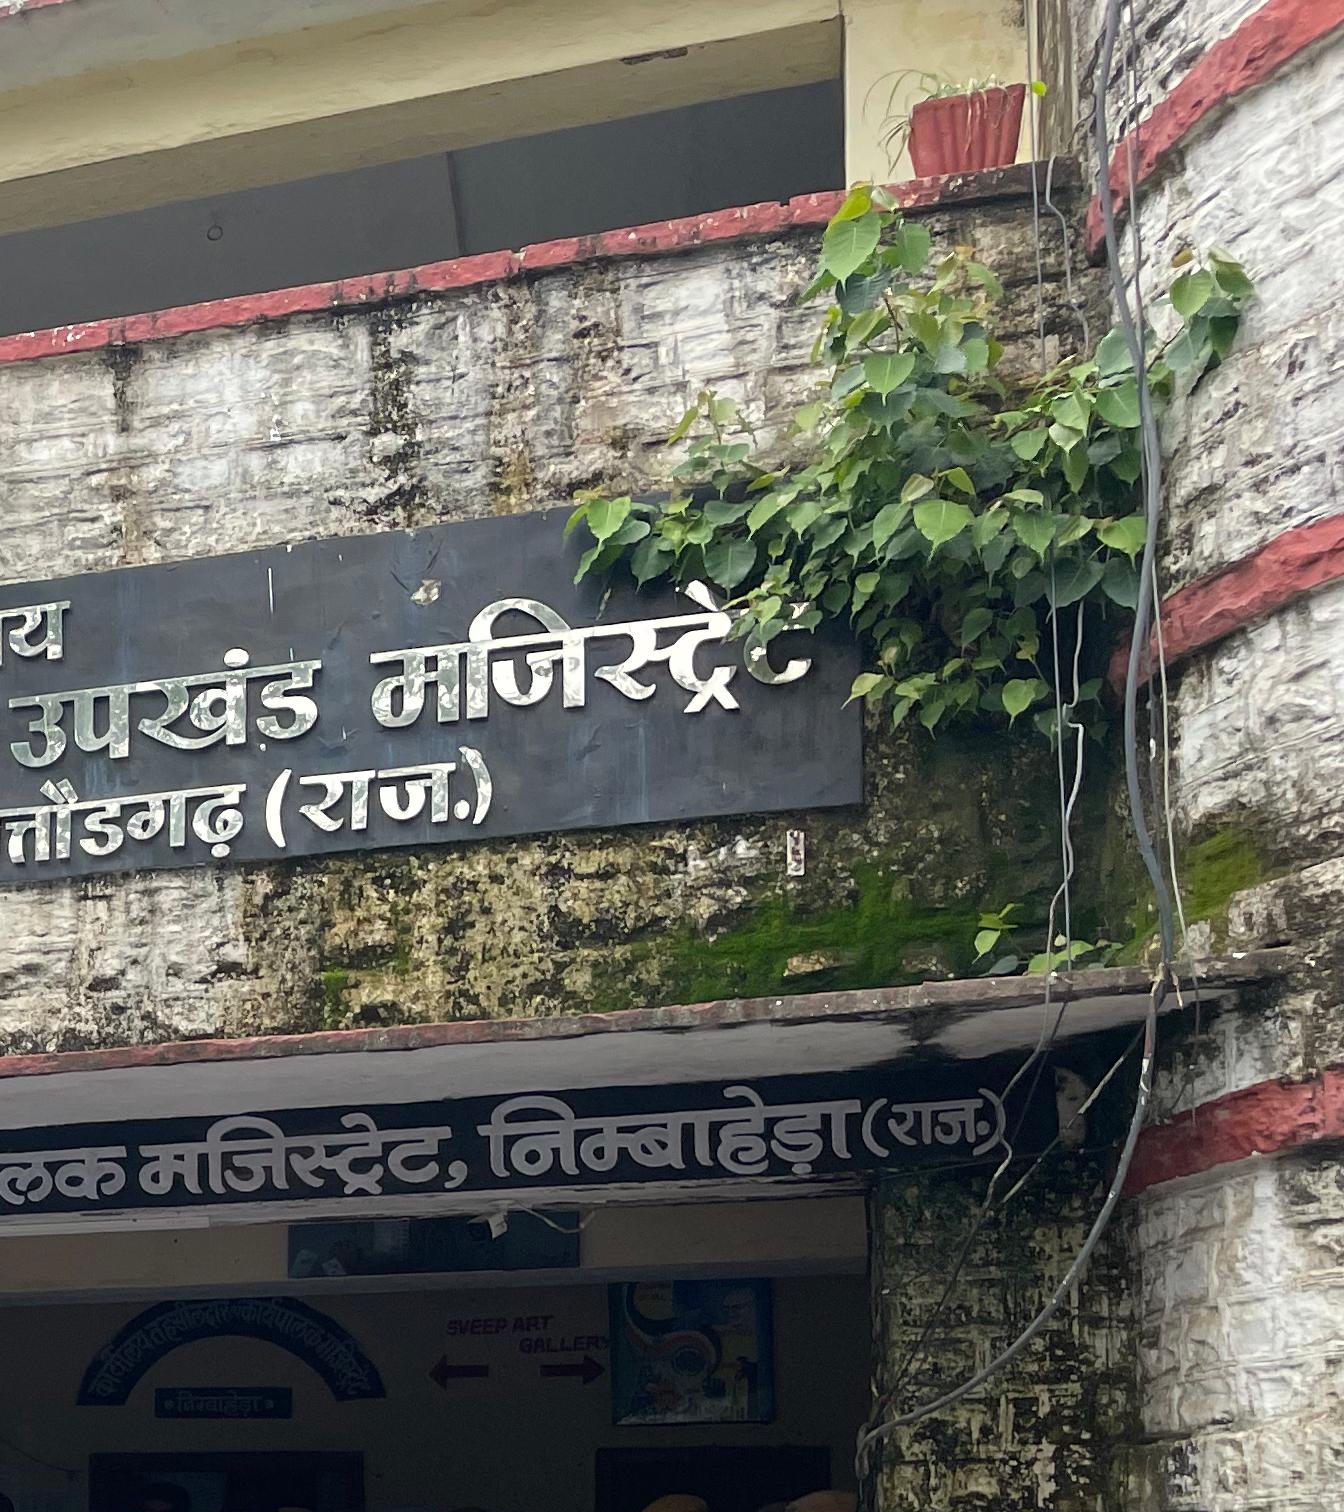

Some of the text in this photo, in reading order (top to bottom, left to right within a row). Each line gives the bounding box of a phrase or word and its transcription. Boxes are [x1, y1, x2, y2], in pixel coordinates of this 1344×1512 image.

[9, 648, 322, 768] उपखंड
[370, 580, 812, 728] मजिस्ट्रेट
[265, 746, 493, 848] (राज.)
[139, 1113, 468, 1195] मजिस्ट्रेट,
[477, 1086, 861, 1178] निम्बाहेड़ा
[512, 1315, 553, 1332] ART
[519, 1336, 610, 1353] GALLERY
